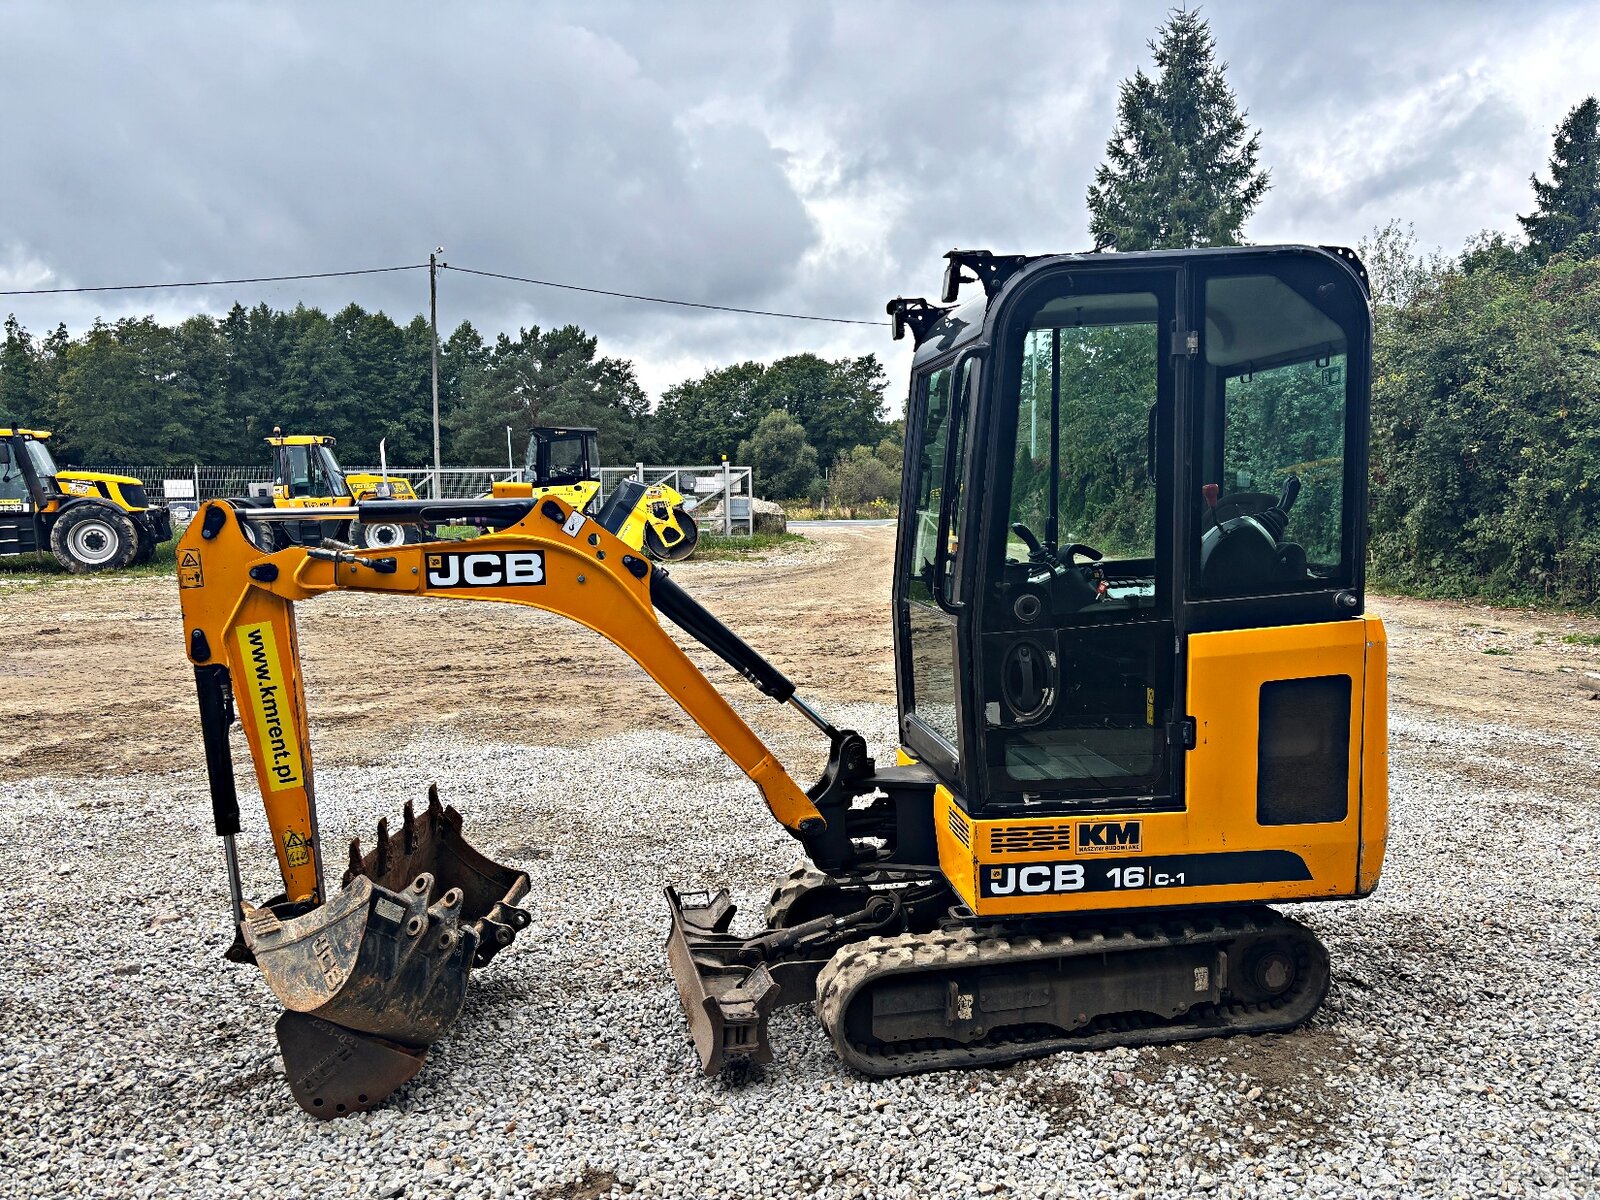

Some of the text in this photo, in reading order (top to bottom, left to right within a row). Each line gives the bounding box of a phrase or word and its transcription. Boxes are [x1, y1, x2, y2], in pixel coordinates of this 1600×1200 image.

[429, 553, 544, 586] JCB
[247, 628, 298, 784] www.kmrent.pl
[1078, 822, 1141, 847] KM
[990, 864, 1086, 895] JCB
[312, 932, 346, 992] JCB
